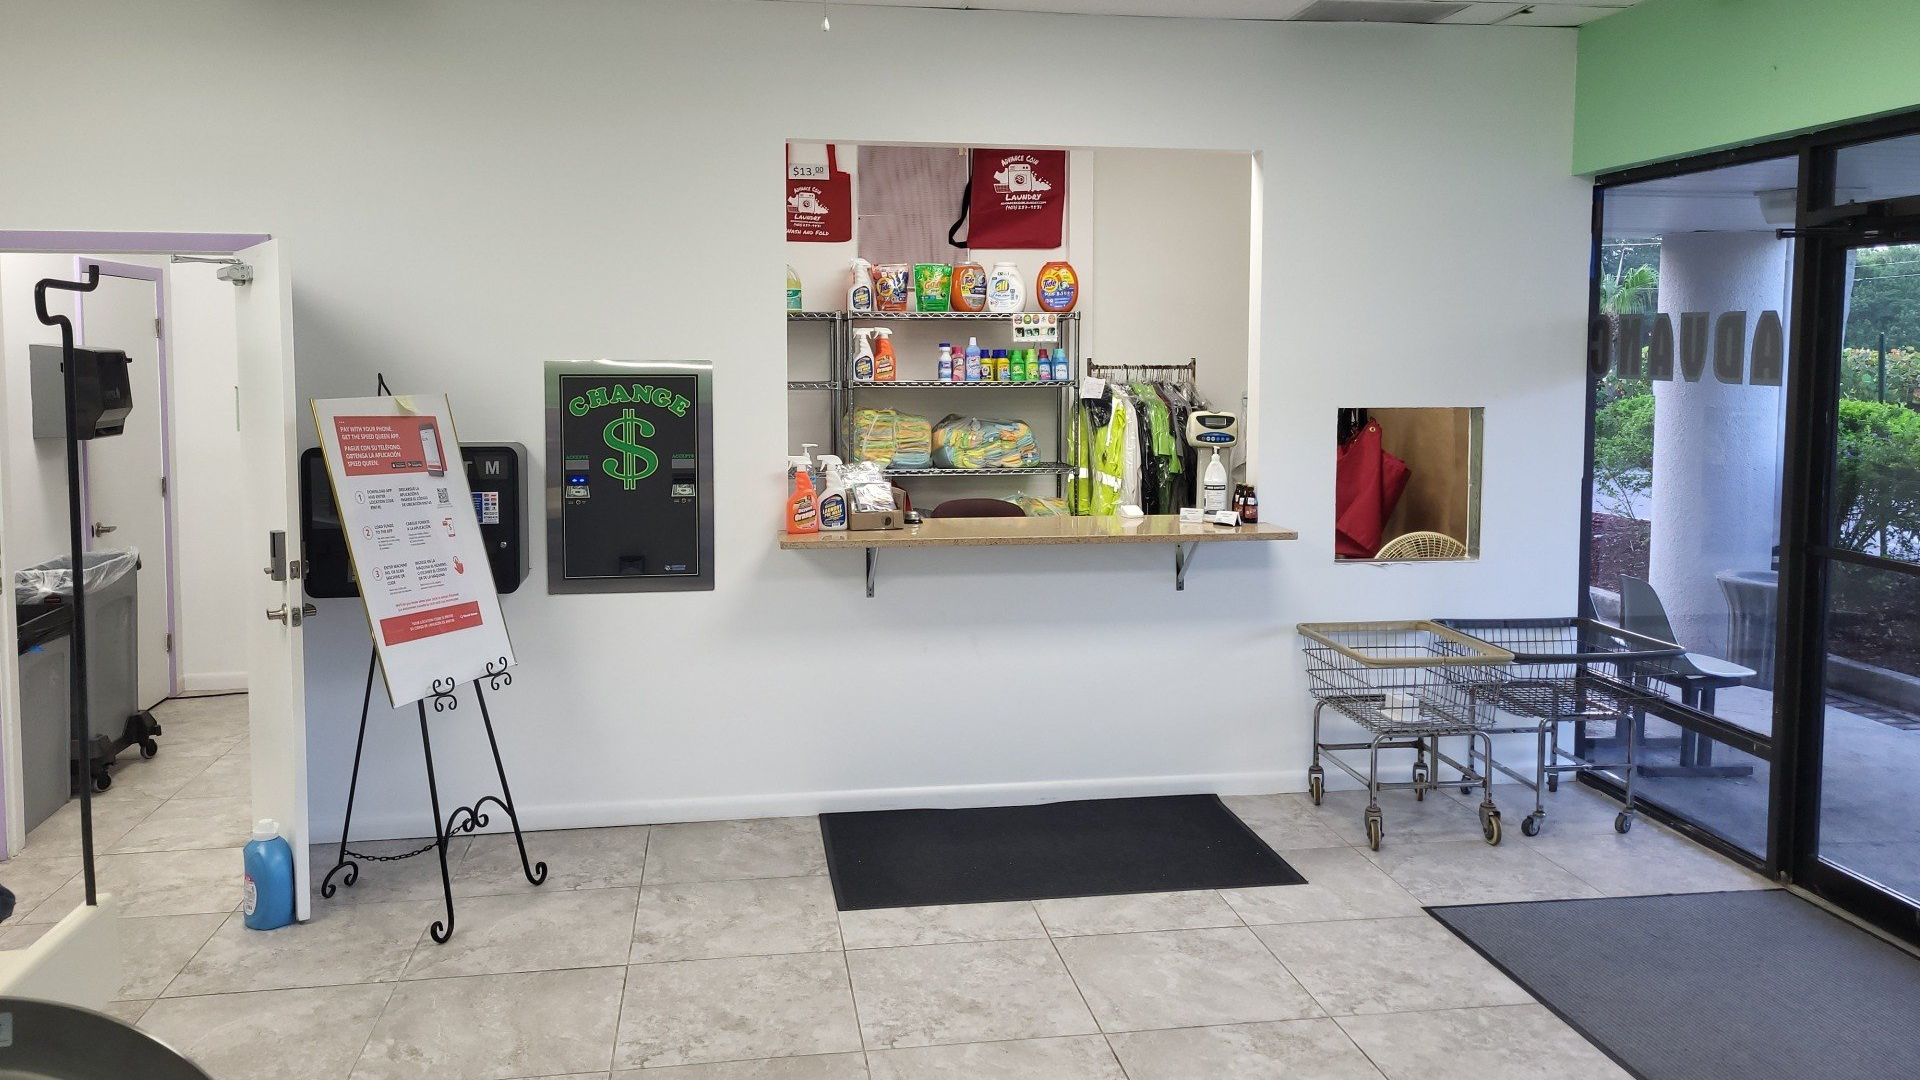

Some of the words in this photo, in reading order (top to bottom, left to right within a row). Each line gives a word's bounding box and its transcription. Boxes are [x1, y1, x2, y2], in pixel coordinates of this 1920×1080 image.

[879, 284, 891, 292] Tide
[997, 281, 1008, 290] all
[1043, 280, 1056, 289] Tide
[569, 384, 691, 417] CHANGE
